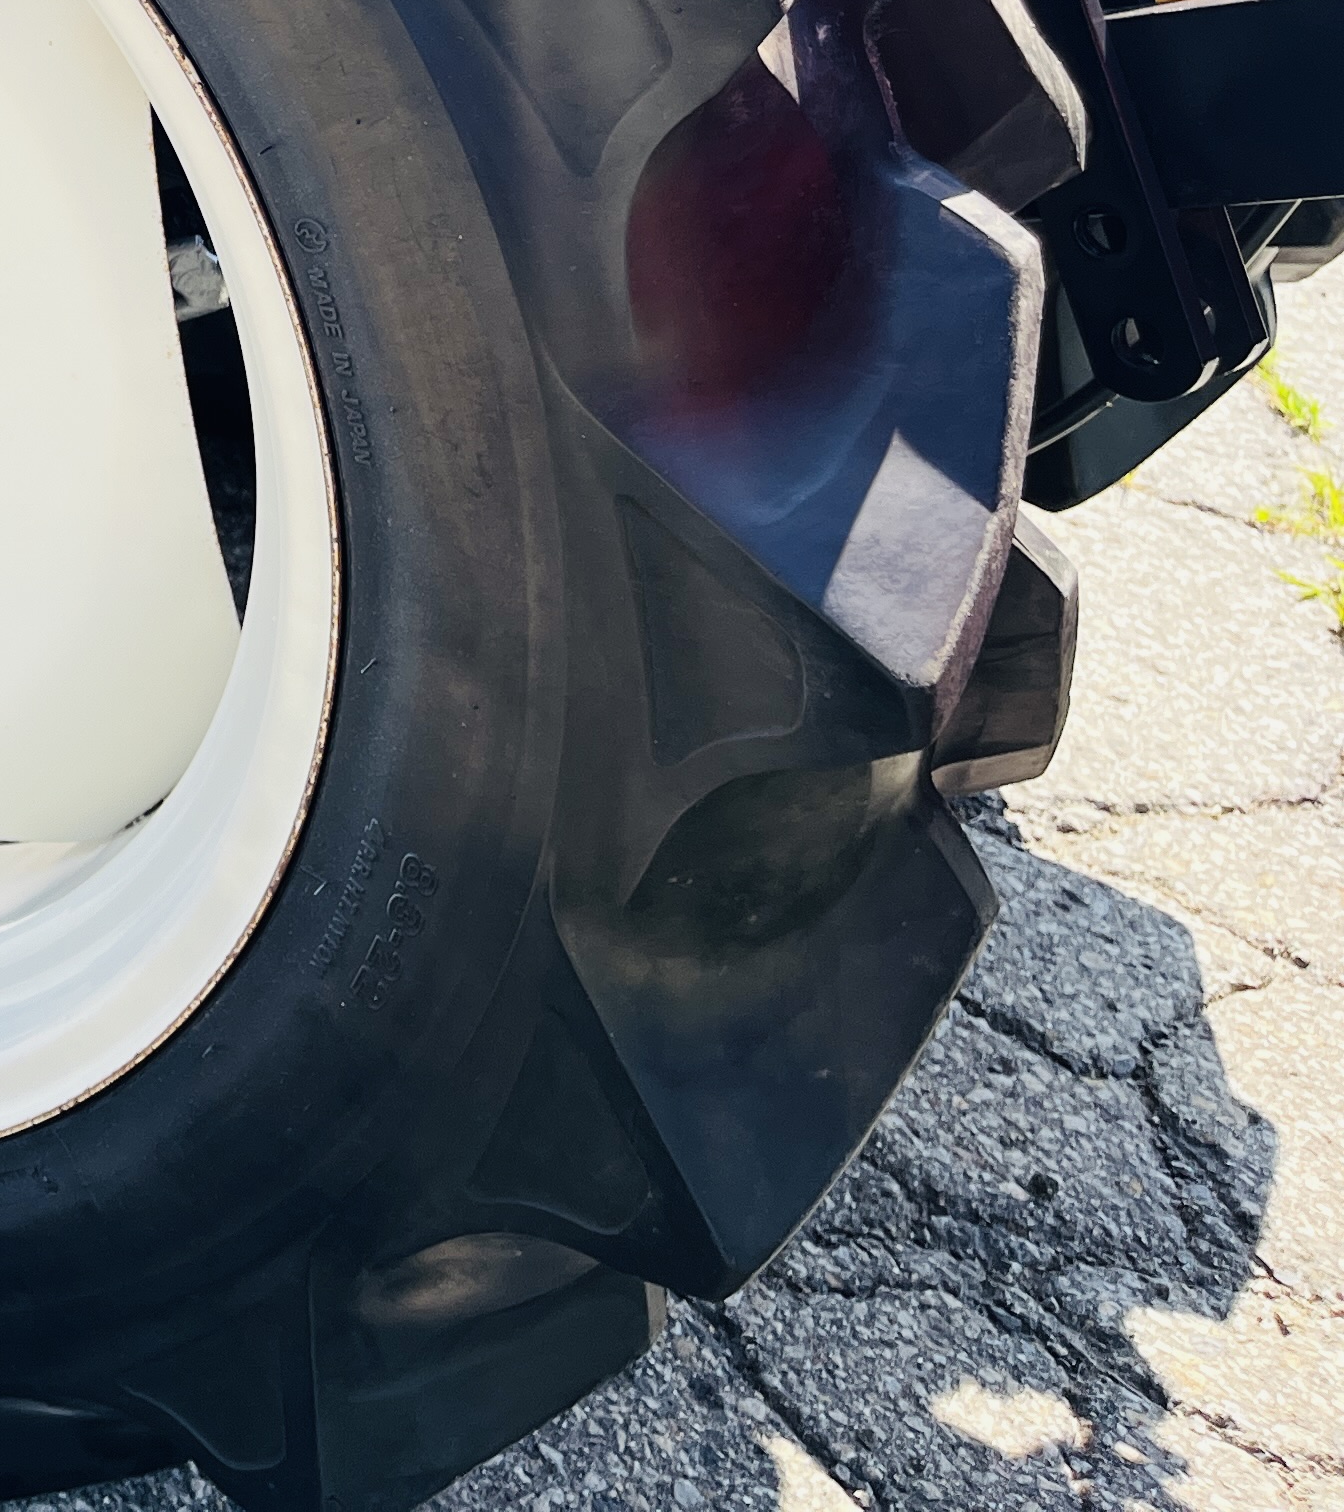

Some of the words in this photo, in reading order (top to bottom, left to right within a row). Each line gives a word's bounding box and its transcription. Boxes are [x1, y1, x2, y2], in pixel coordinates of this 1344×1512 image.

[307, 265, 345, 341] MADE
[331, 351, 353, 377] IN
[341, 389, 373, 467] JAPAN
[350, 851, 439, 1013] 8.3-22
